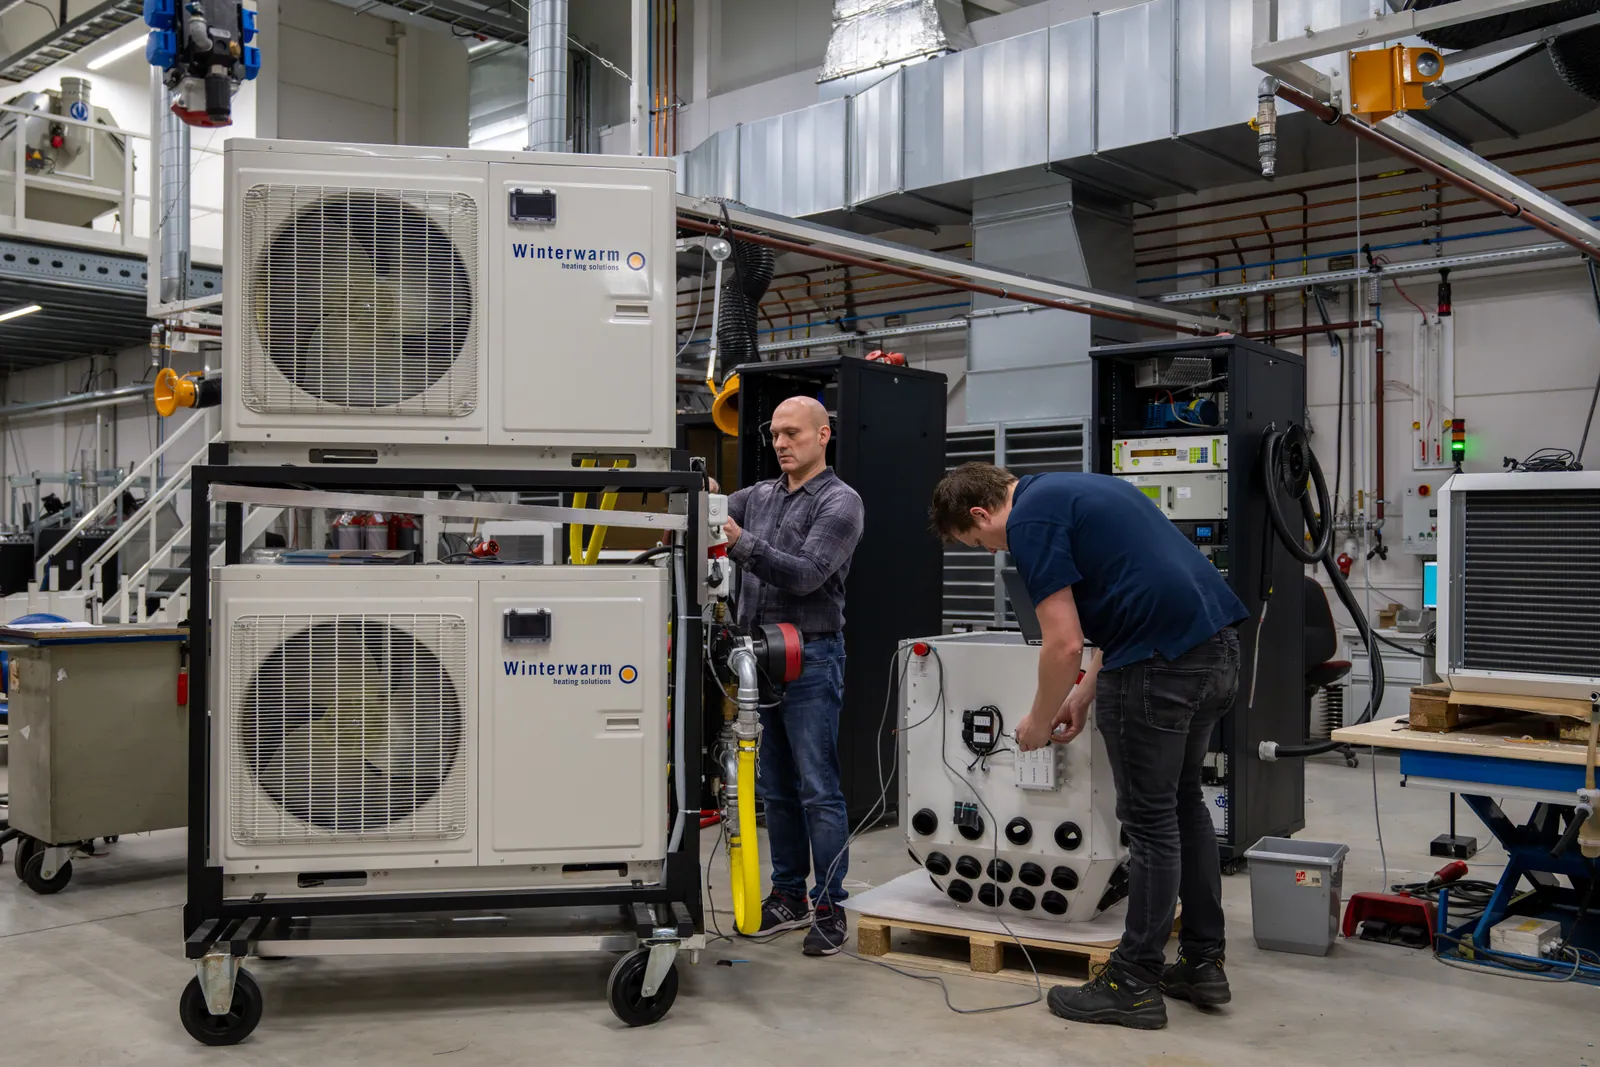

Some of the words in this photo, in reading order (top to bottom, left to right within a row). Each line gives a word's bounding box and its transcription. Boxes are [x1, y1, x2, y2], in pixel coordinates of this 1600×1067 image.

[513, 244, 619, 261] Winterwarm
[562, 263, 587, 271] heating
[589, 263, 619, 271] solutions
[504, 661, 612, 676] Winterwarm
[553, 678, 579, 686] heating
